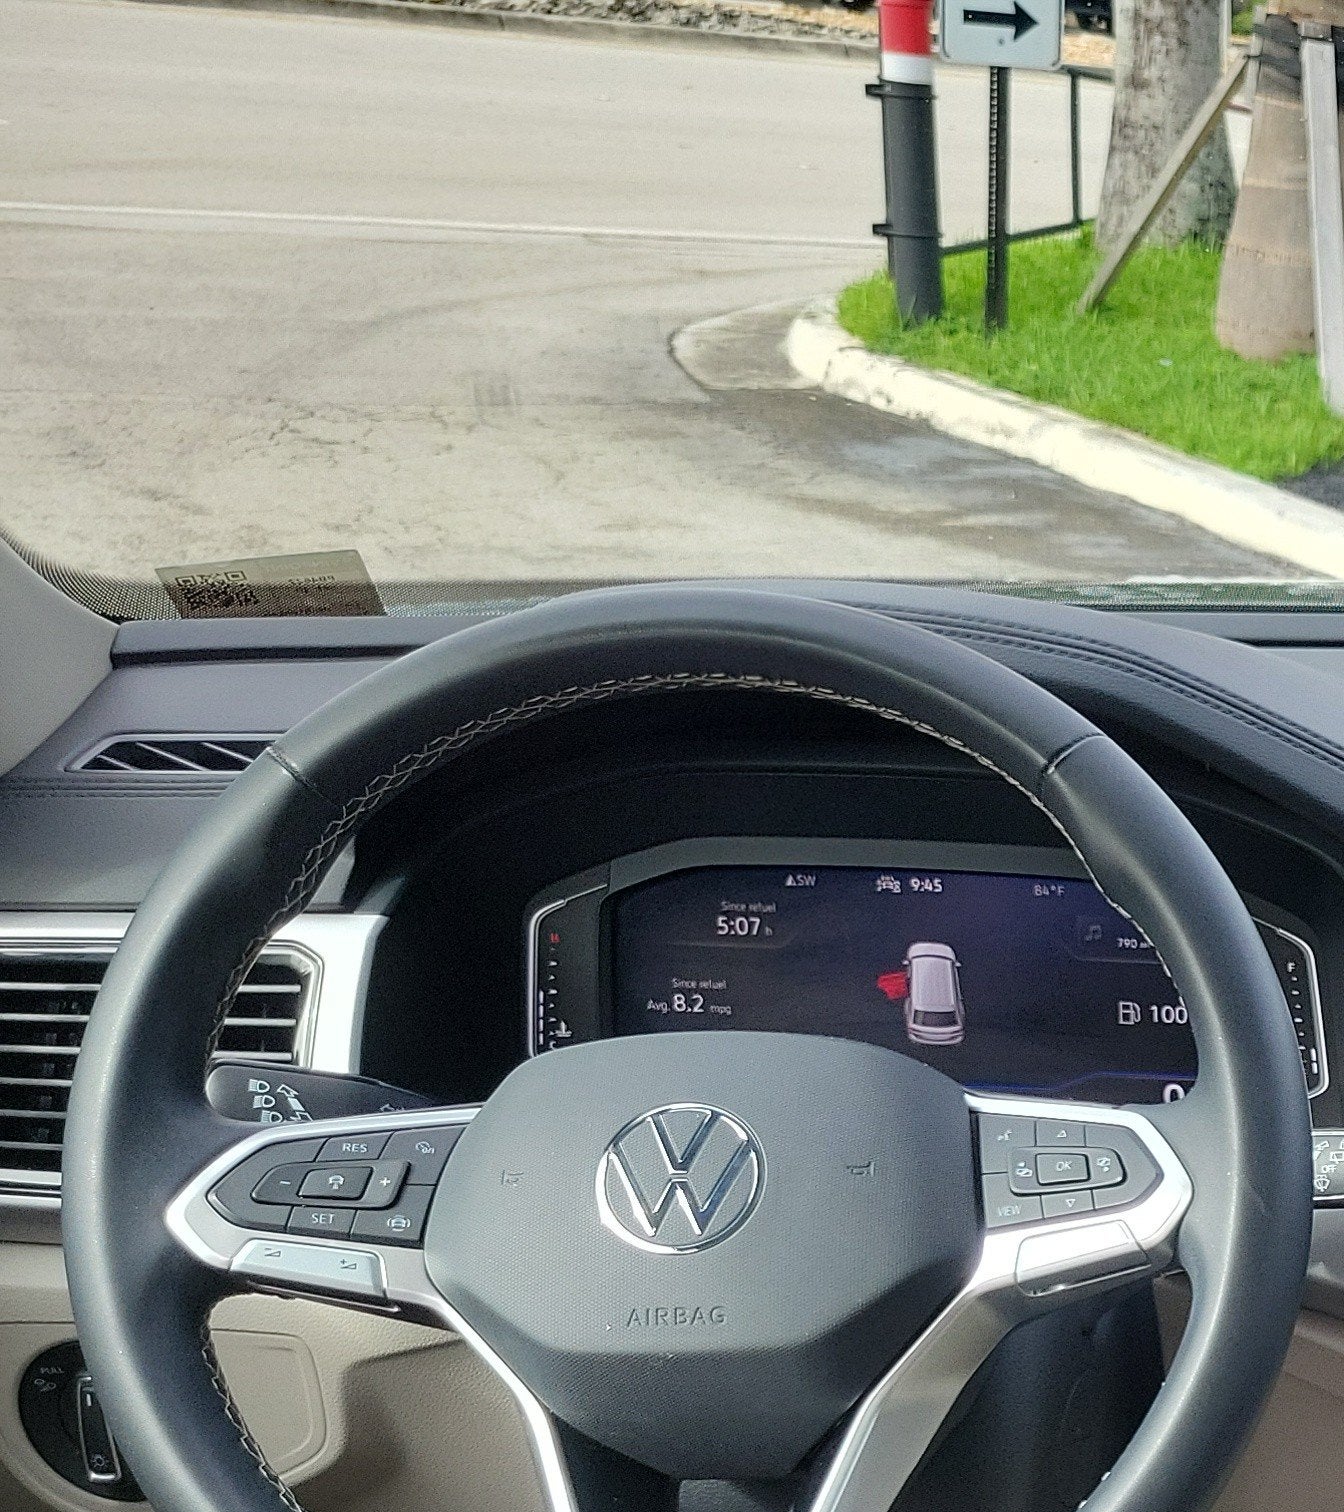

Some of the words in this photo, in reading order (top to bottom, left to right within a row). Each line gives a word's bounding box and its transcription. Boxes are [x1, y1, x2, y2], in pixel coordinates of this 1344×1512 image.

[909, 878, 943, 893] 9:45
[721, 901, 746, 912] Since
[716, 916, 761, 936] 5:07
[671, 978, 697, 989] Since
[647, 1000, 671, 1014] Avg.
[673, 994, 704, 1013] 8.2
[710, 1005, 732, 1016] mpg
[1149, 1006, 1188, 1024] 100
[342, 1143, 368, 1153] RES
[1056, 1161, 1072, 1171] OK
[998, 1205, 1022, 1216] VIEW
[311, 1213, 335, 1224] SET
[627, 1306, 727, 1328] AIRBAG
